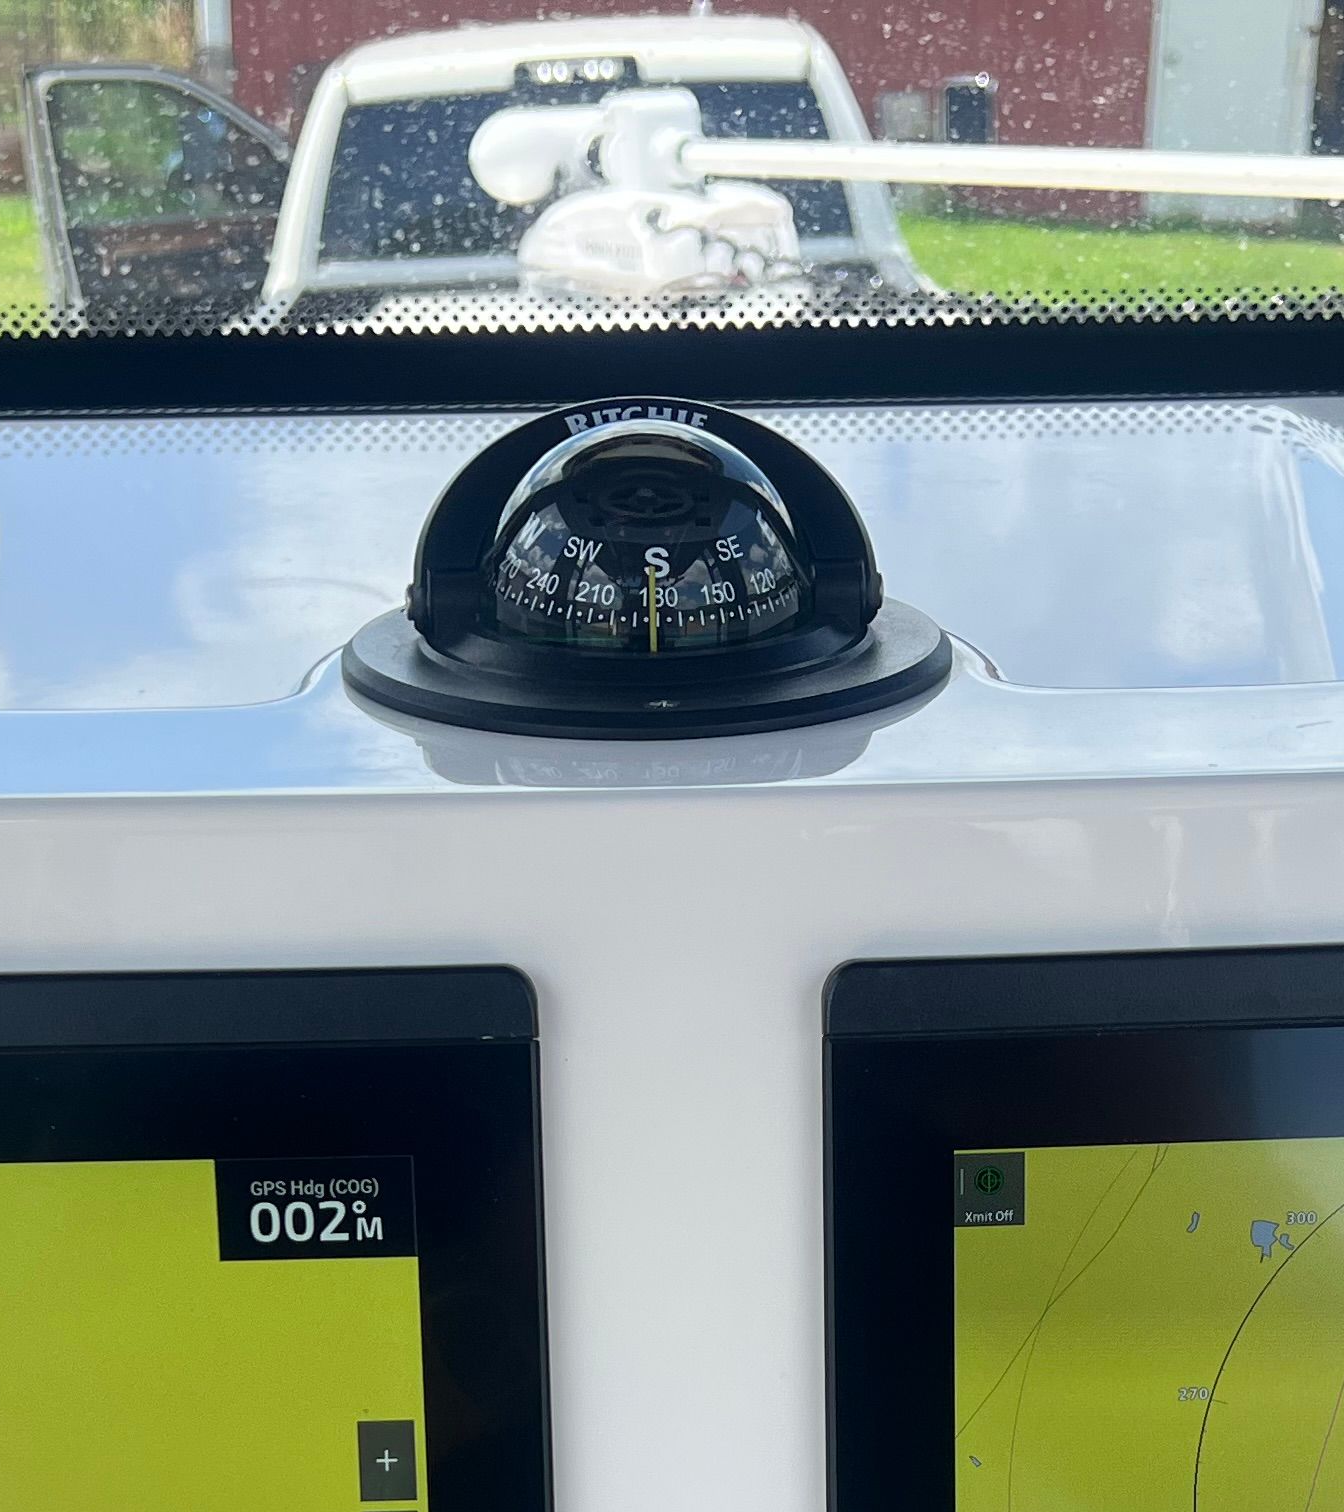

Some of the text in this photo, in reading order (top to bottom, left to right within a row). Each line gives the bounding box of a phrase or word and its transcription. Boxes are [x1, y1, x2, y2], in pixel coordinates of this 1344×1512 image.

[563, 536, 604, 563] SW
[715, 535, 745, 562] SE
[643, 546, 671, 579] S
[526, 567, 560, 595] 240
[574, 581, 616, 606] 210
[700, 580, 736, 605] 150
[750, 568, 776, 595] 120
[249, 1177, 380, 1199] GPS Hdg (COG)
[965, 1209, 1014, 1224] Xmit Off
[1285, 1211, 1318, 1225] 300
[1177, 1386, 1210, 1402] 270
